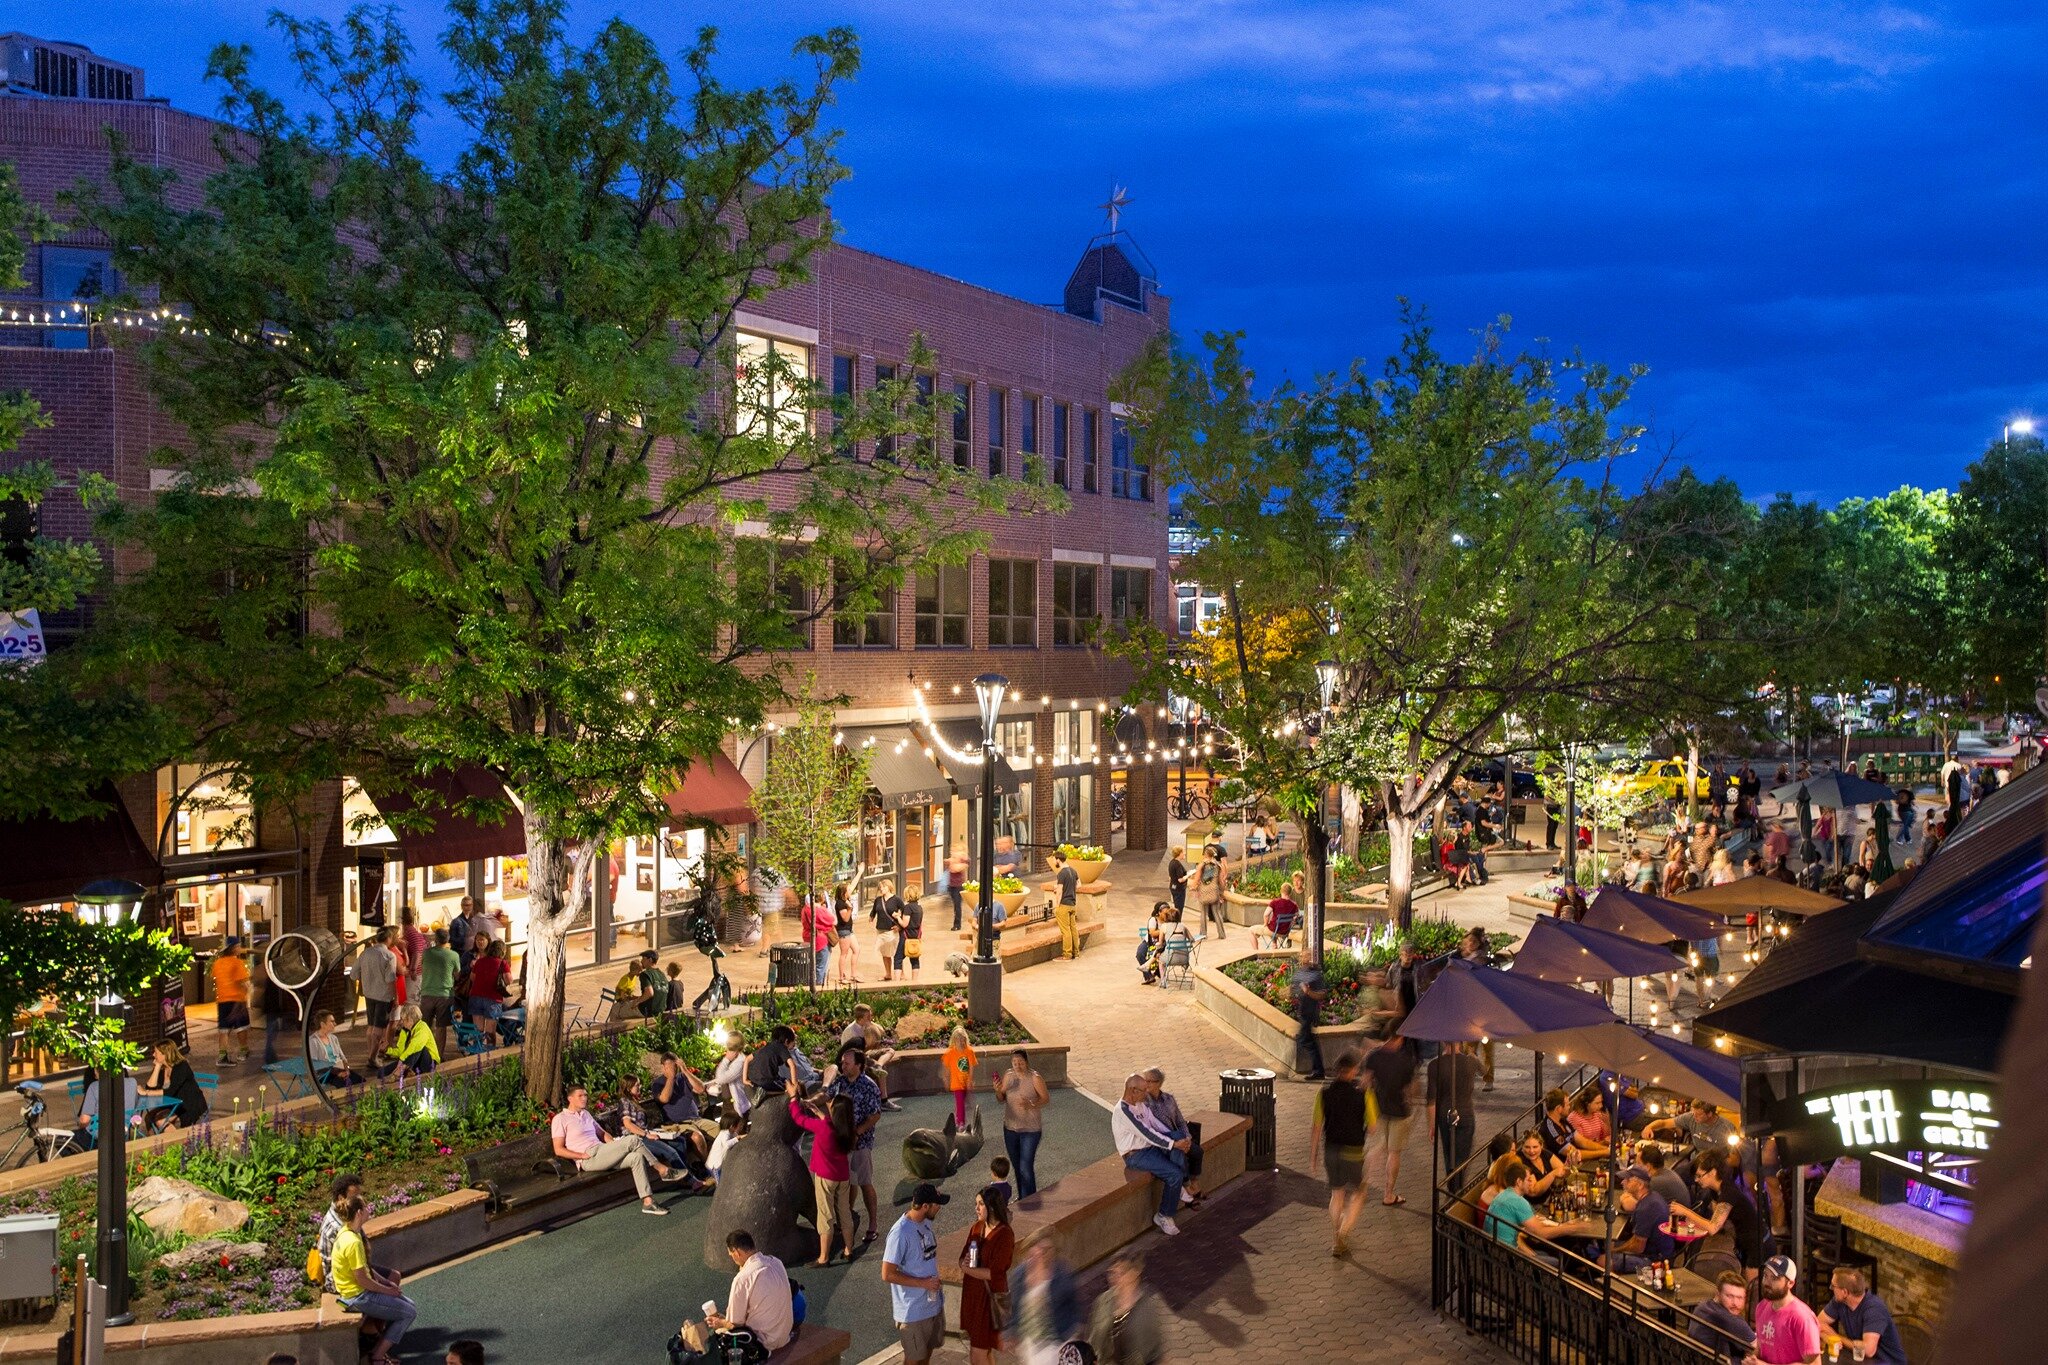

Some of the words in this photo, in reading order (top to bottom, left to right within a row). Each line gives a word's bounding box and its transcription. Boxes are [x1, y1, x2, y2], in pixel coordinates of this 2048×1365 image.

[1931, 1089, 1991, 1113] BAR
[1831, 1089, 1901, 1147] YETI
[1923, 1126, 1989, 1150] GRIL
